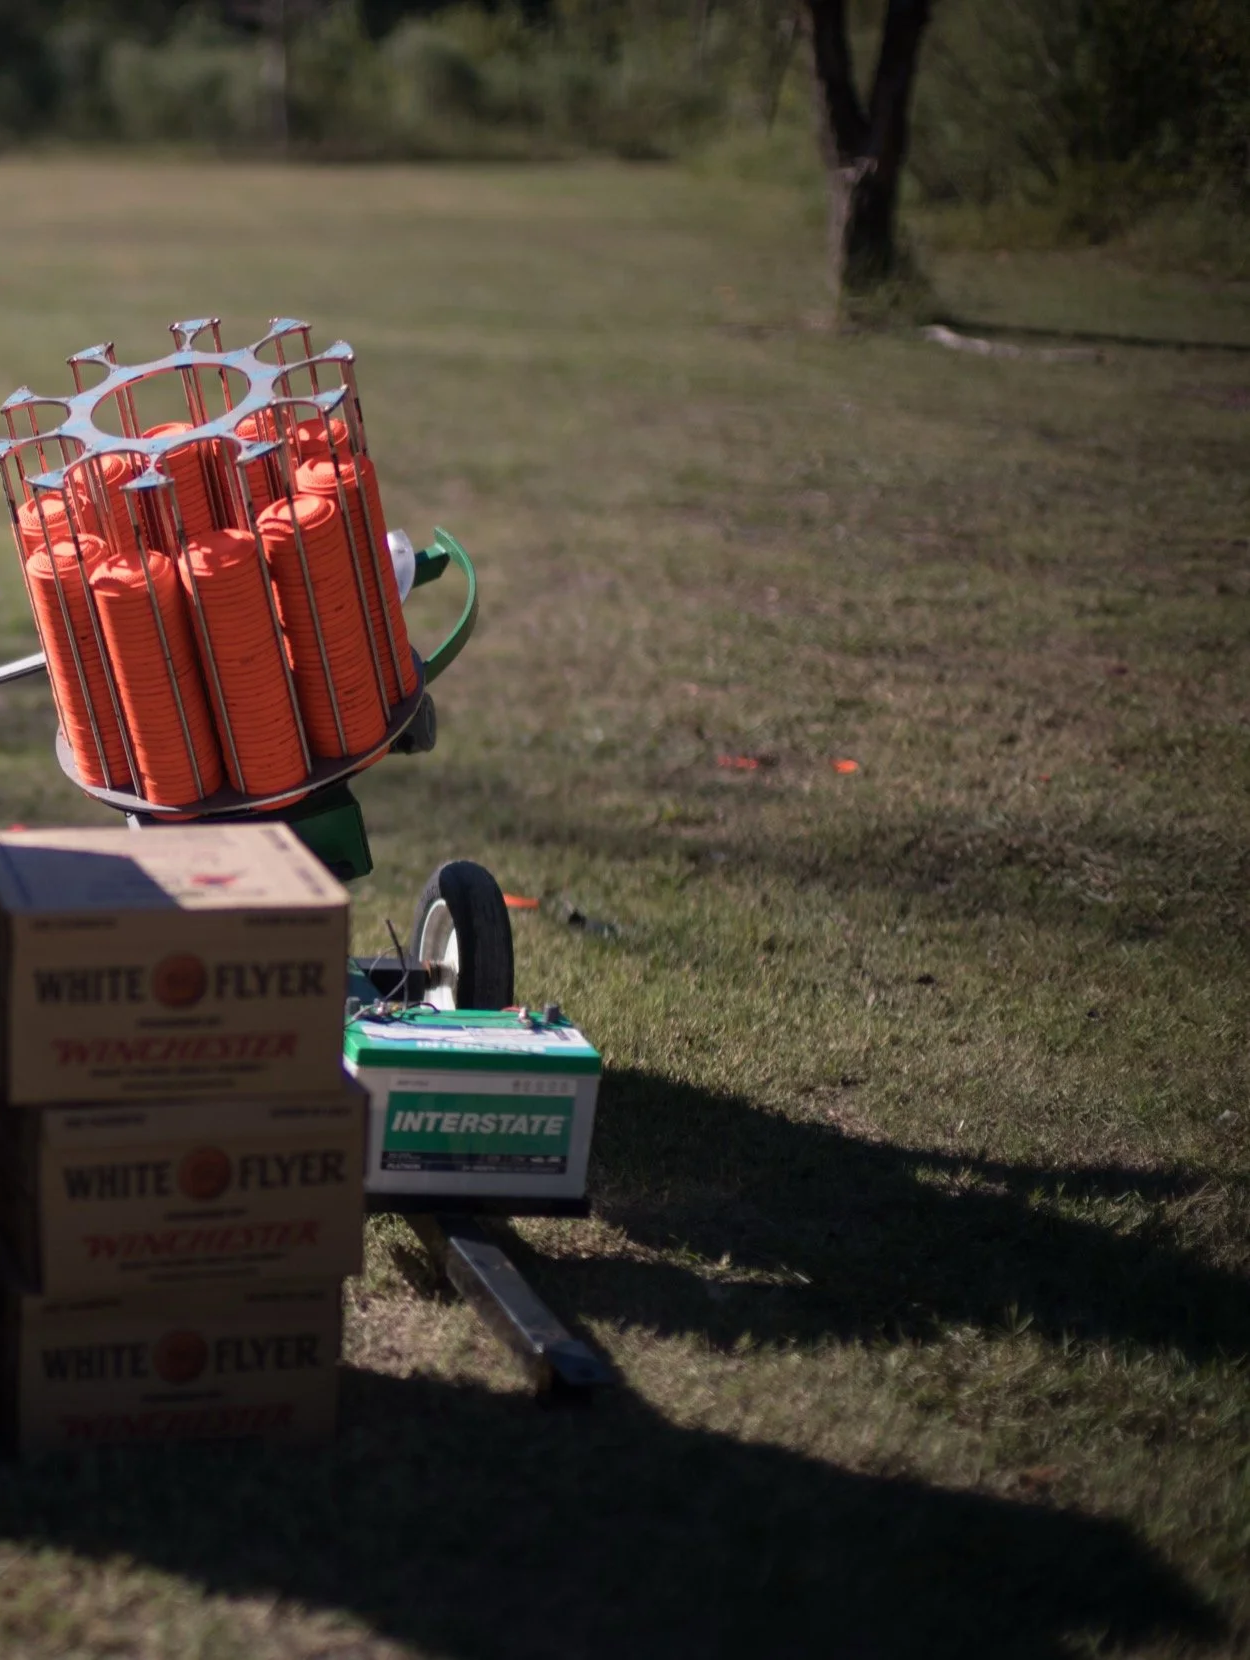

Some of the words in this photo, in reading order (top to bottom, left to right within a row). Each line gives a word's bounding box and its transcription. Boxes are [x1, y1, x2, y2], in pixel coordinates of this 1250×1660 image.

[34, 965, 144, 1004] WHITE
[215, 961, 327, 1000] FLYER
[51, 1031, 298, 1067] WINCHESTER
[392, 1110, 566, 1136] INTERSTATE
[63, 1161, 172, 1200] WHITE
[239, 1150, 346, 1190] FLYER
[82, 1219, 321, 1259] WINCHESTER
[42, 1343, 149, 1382] WHITE
[215, 1334, 321, 1376] FLYER
